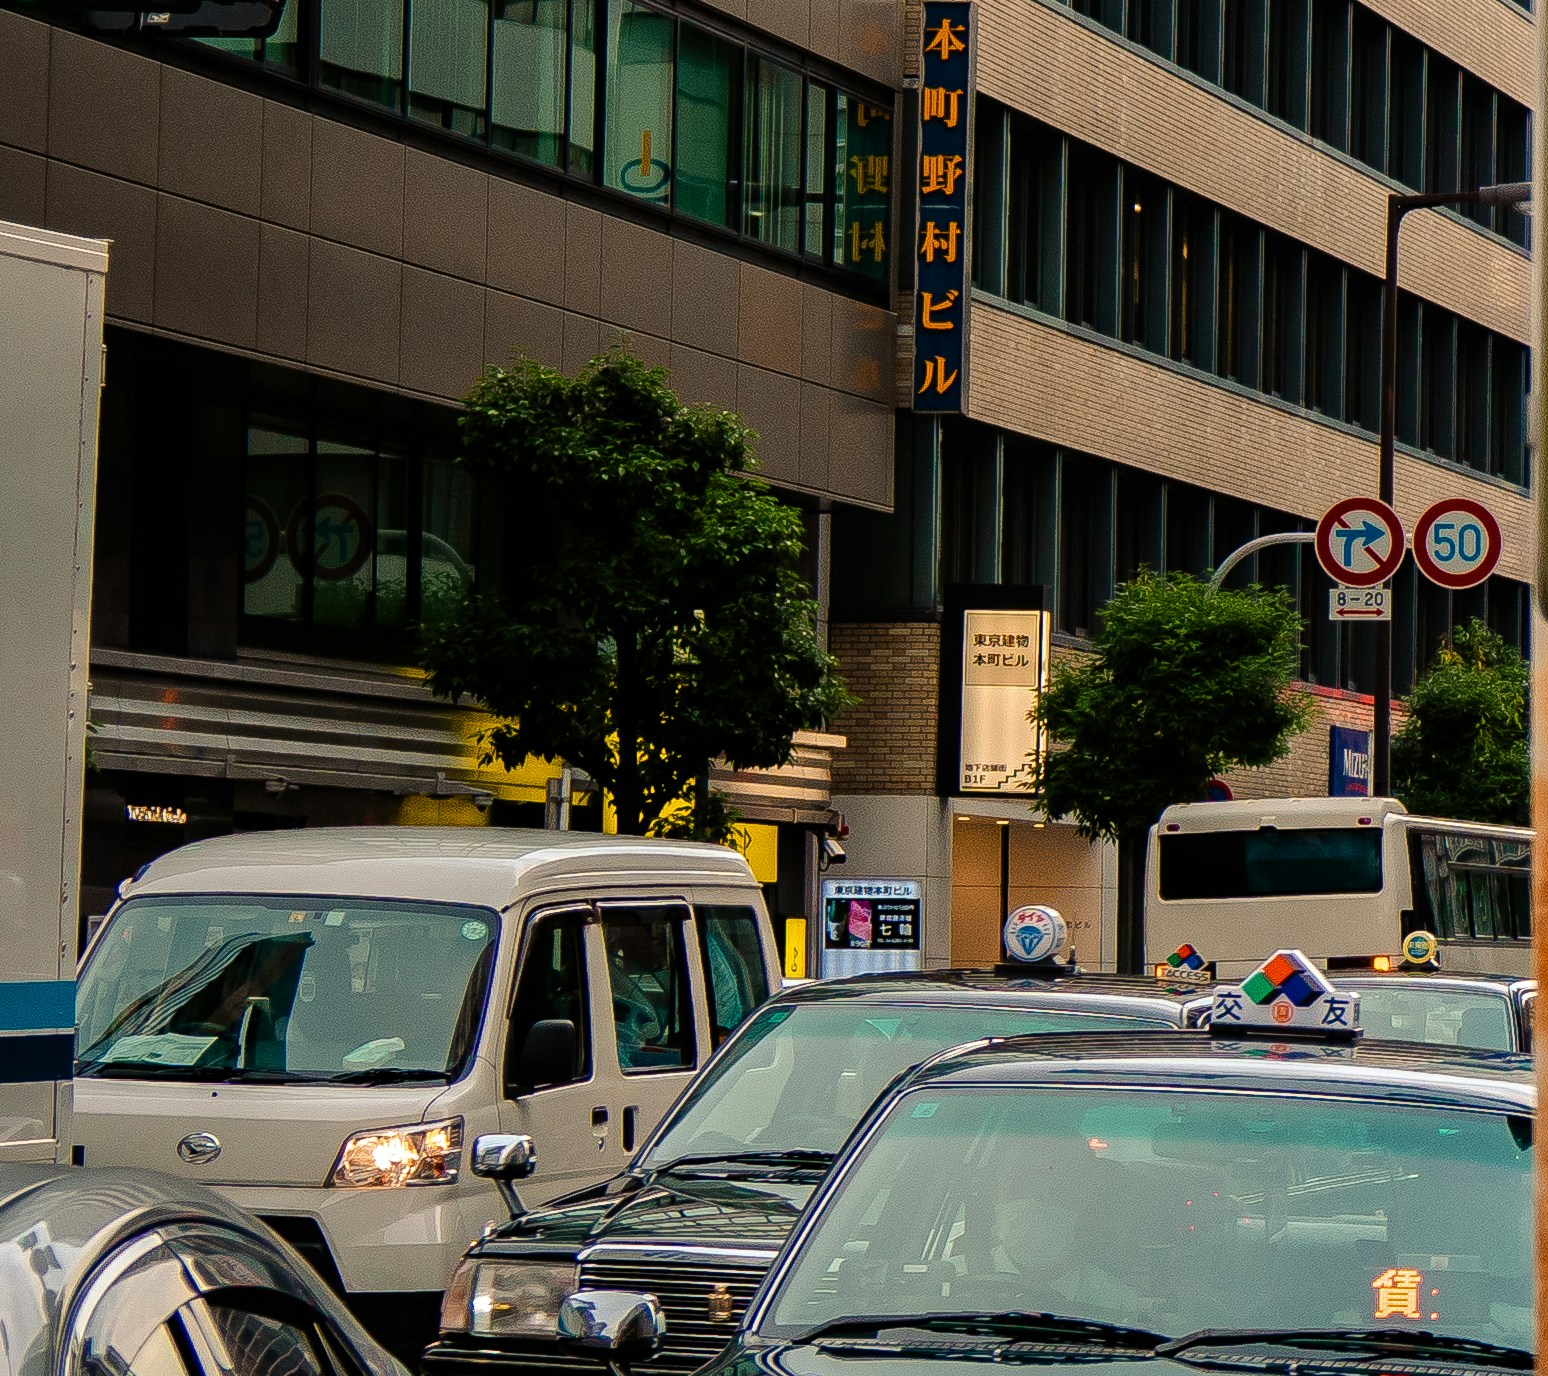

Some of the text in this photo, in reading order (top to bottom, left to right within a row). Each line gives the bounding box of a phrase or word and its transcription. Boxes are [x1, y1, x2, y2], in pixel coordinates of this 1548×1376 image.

[917, 17, 967, 396] 本町野村ビル
[1433, 523, 1483, 563] 50
[973, 633, 1030, 648] 東京建物
[972, 653, 1030, 667] 本町ビル
[1215, 992, 1351, 1026] 交 友
